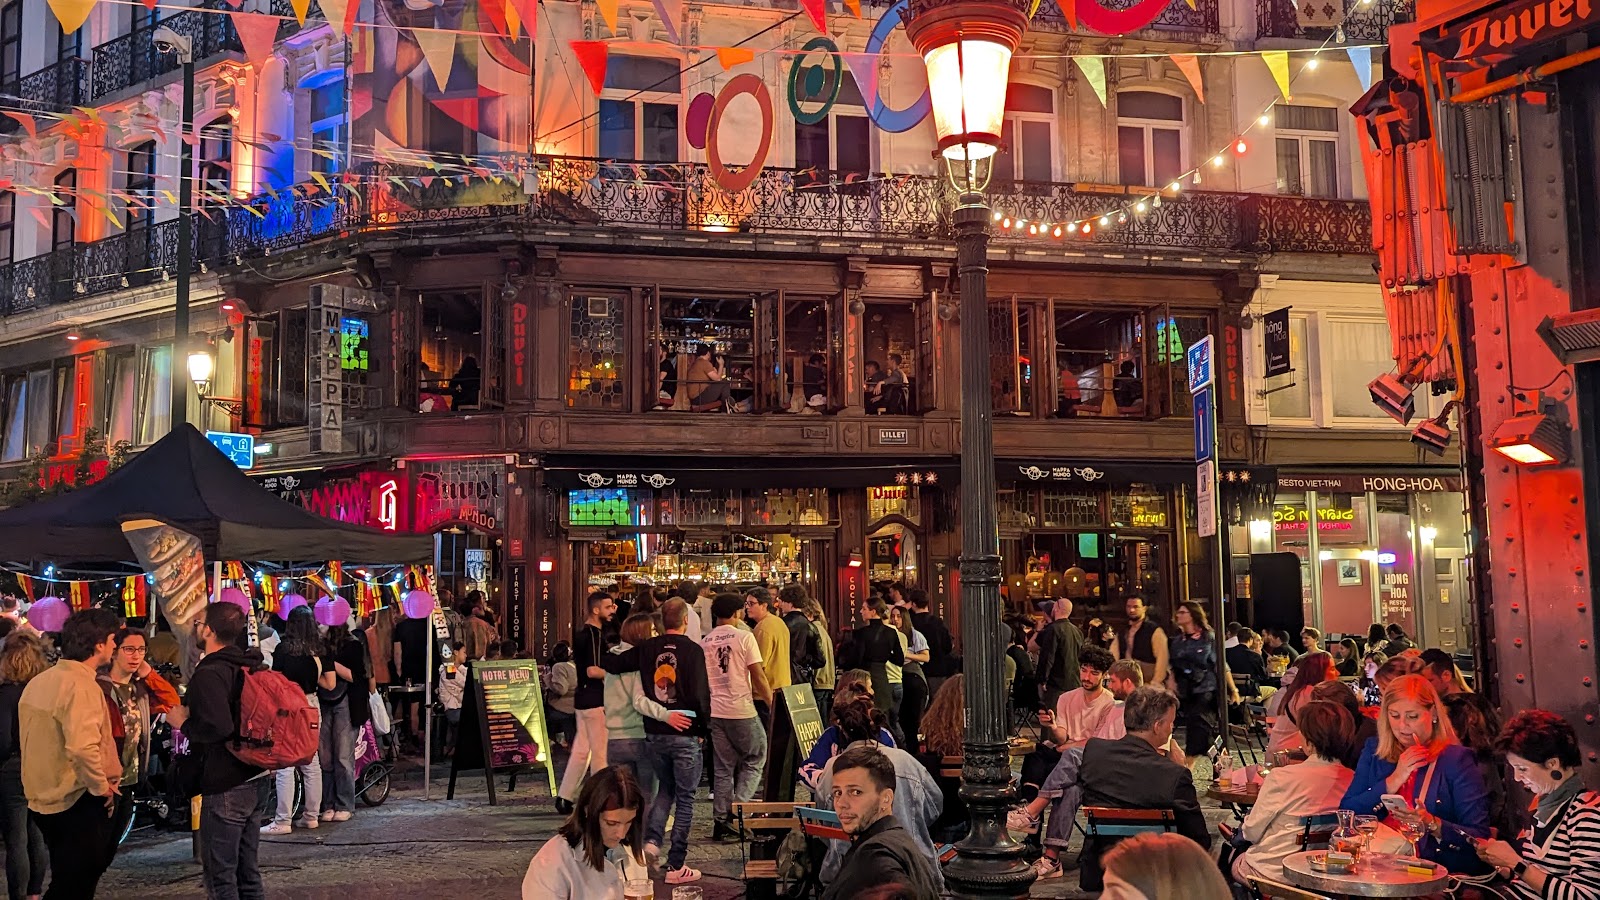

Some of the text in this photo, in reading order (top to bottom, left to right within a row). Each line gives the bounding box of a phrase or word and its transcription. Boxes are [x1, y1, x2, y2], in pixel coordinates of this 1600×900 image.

[513, 303, 527, 386] Duvel
[326, 311, 338, 426] MAPPA
[1224, 325, 1238, 401] Duvel
[1278, 479, 1341, 487] RESTO VIET-THAI
[1362, 477, 1443, 491] HONG-HOA
[459, 507, 495, 529] MUNDO
[1385, 573, 1409, 584] HONG
[1390, 588, 1408, 598] HOA
[482, 669, 530, 681] NOTRE MENU
[797, 720, 822, 741] HAPPY
